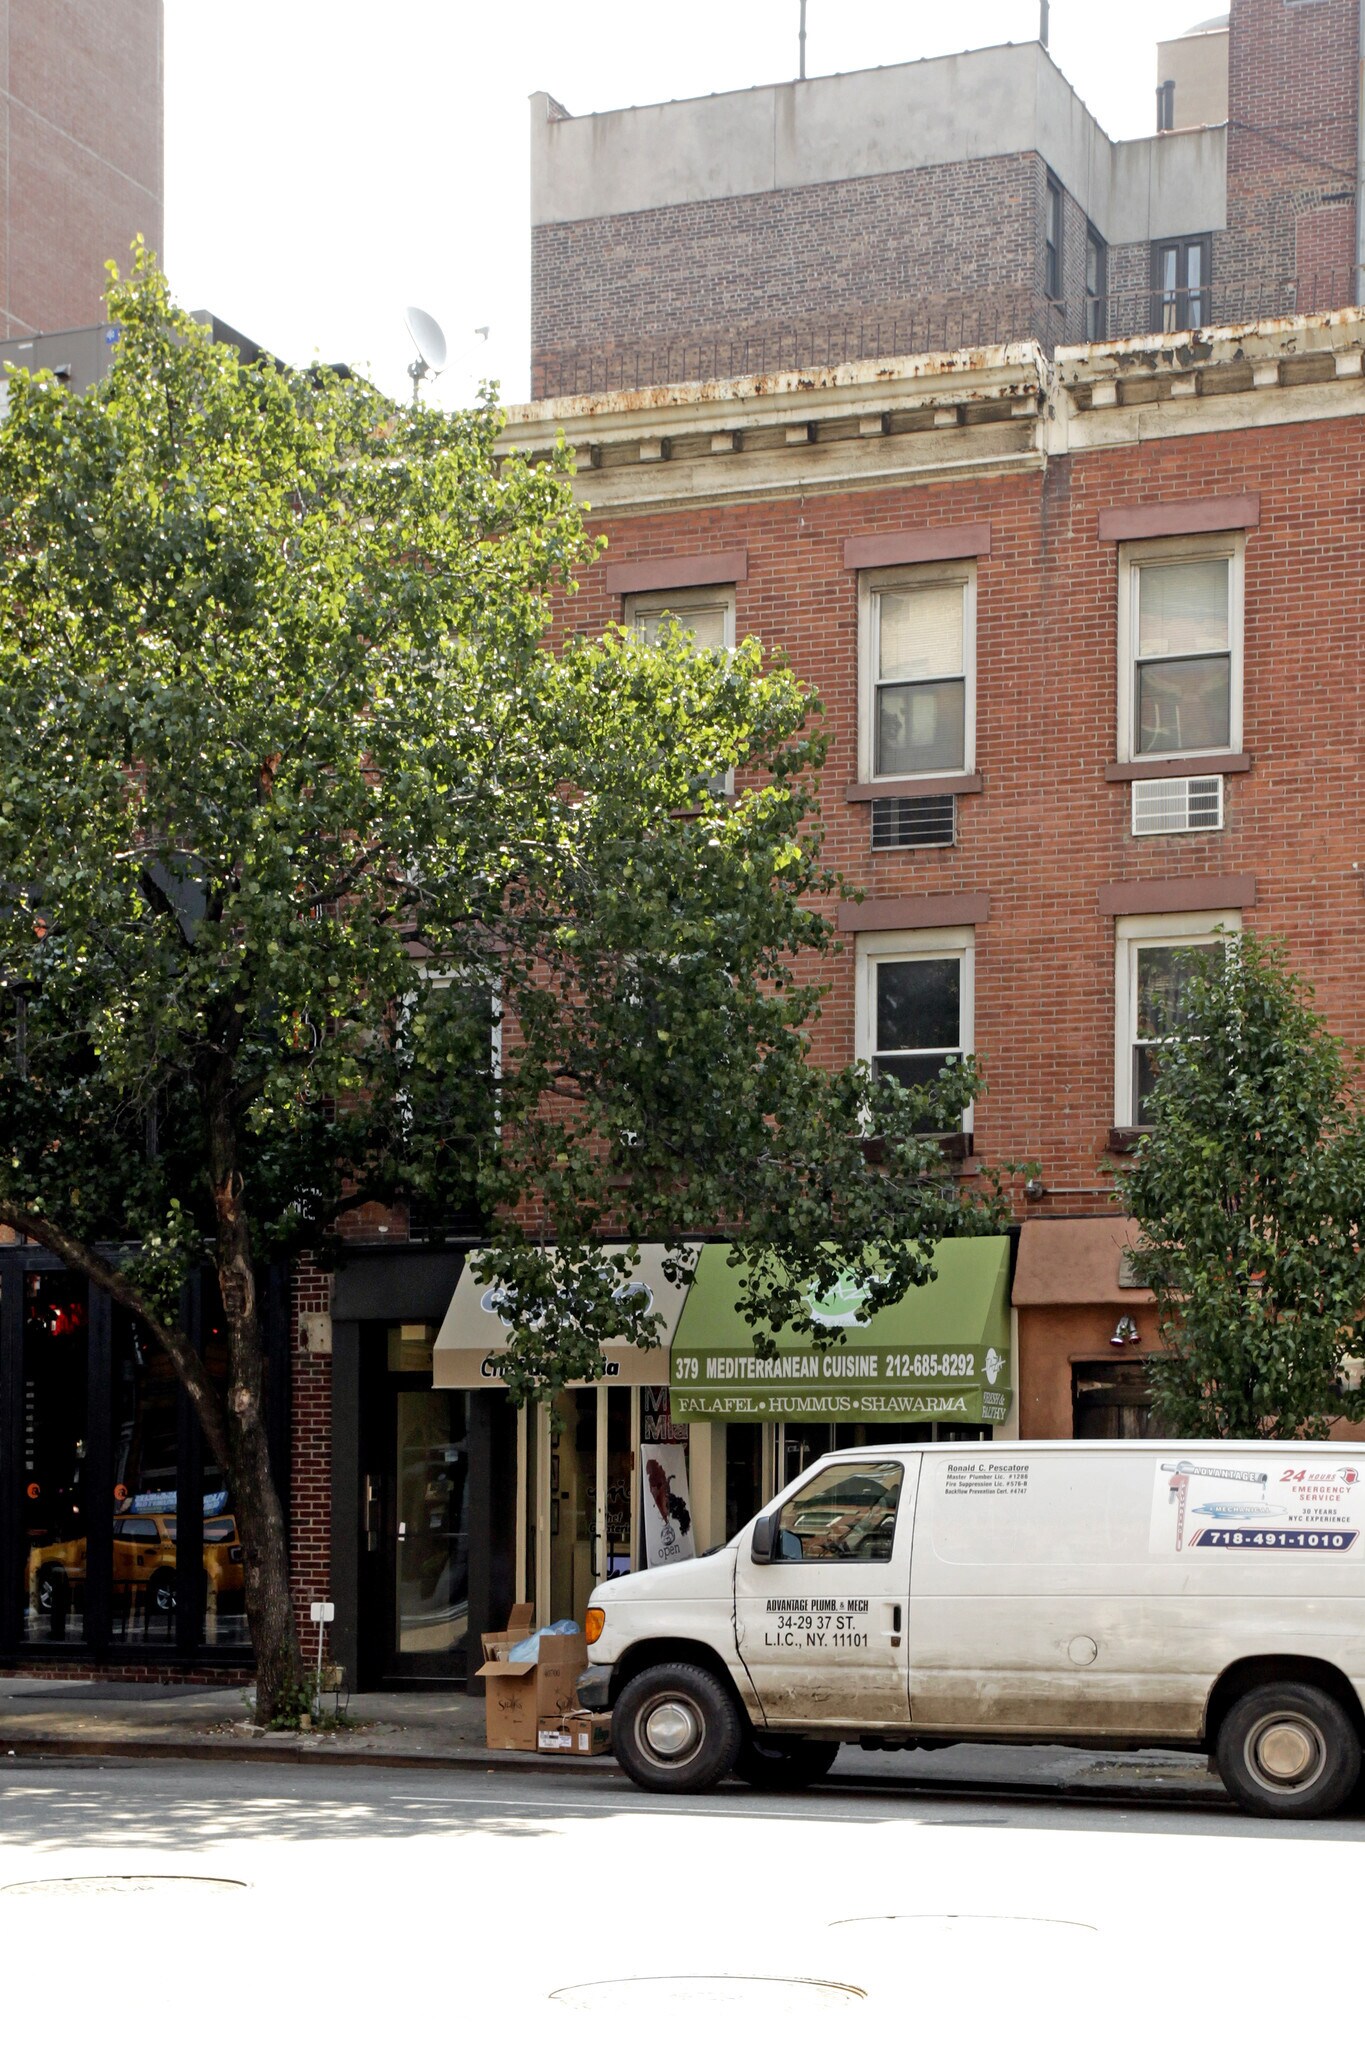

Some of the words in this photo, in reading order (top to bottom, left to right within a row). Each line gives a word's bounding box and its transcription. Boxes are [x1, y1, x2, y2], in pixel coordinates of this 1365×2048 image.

[676, 1357, 699, 1379] 379
[706, 1356, 819, 1379] MEDITERRANEAN
[823, 1355, 878, 1378] CUISINE
[886, 1353, 974, 1377] 212-685-8292
[678, 1398, 758, 1413] FALAFEL
[768, 1397, 850, 1412] HUMMUS
[861, 1396, 968, 1412] SHAWARMA
[947, 1464, 975, 1472] Ronald
[978, 1464, 986, 1472] C.
[988, 1464, 1029, 1472] Pescatore
[1193, 1467, 1257, 1482] ADVANTAGE
[1279, 1469, 1307, 1482] 24
[1308, 1473, 1336, 1481] HOURS
[1292, 1486, 1352, 1494] EMERGENCY
[1300, 1494, 1341, 1502] SERVICE
[1215, 1505, 1270, 1513] MECHANICAL
[1314, 1508, 1337, 1516] YEARS
[1210, 1532, 1343, 1547] 718-491-1010
[657, 1544, 681, 1561] open
[766, 1599, 808, 1612] ADVANTAGE
[811, 1599, 838, 1612] PLUMB.
[840, 1601, 845, 1610] &
[847, 1599, 869, 1612] MECH
[777, 1616, 812, 1629] 34-29
[817, 1616, 832, 1629] 37
[836, 1616, 856, 1630] ST.
[765, 1632, 802, 1649] L.I.C.,
[806, 1633, 828, 1647] NY.
[832, 1633, 868, 1647] 11101
